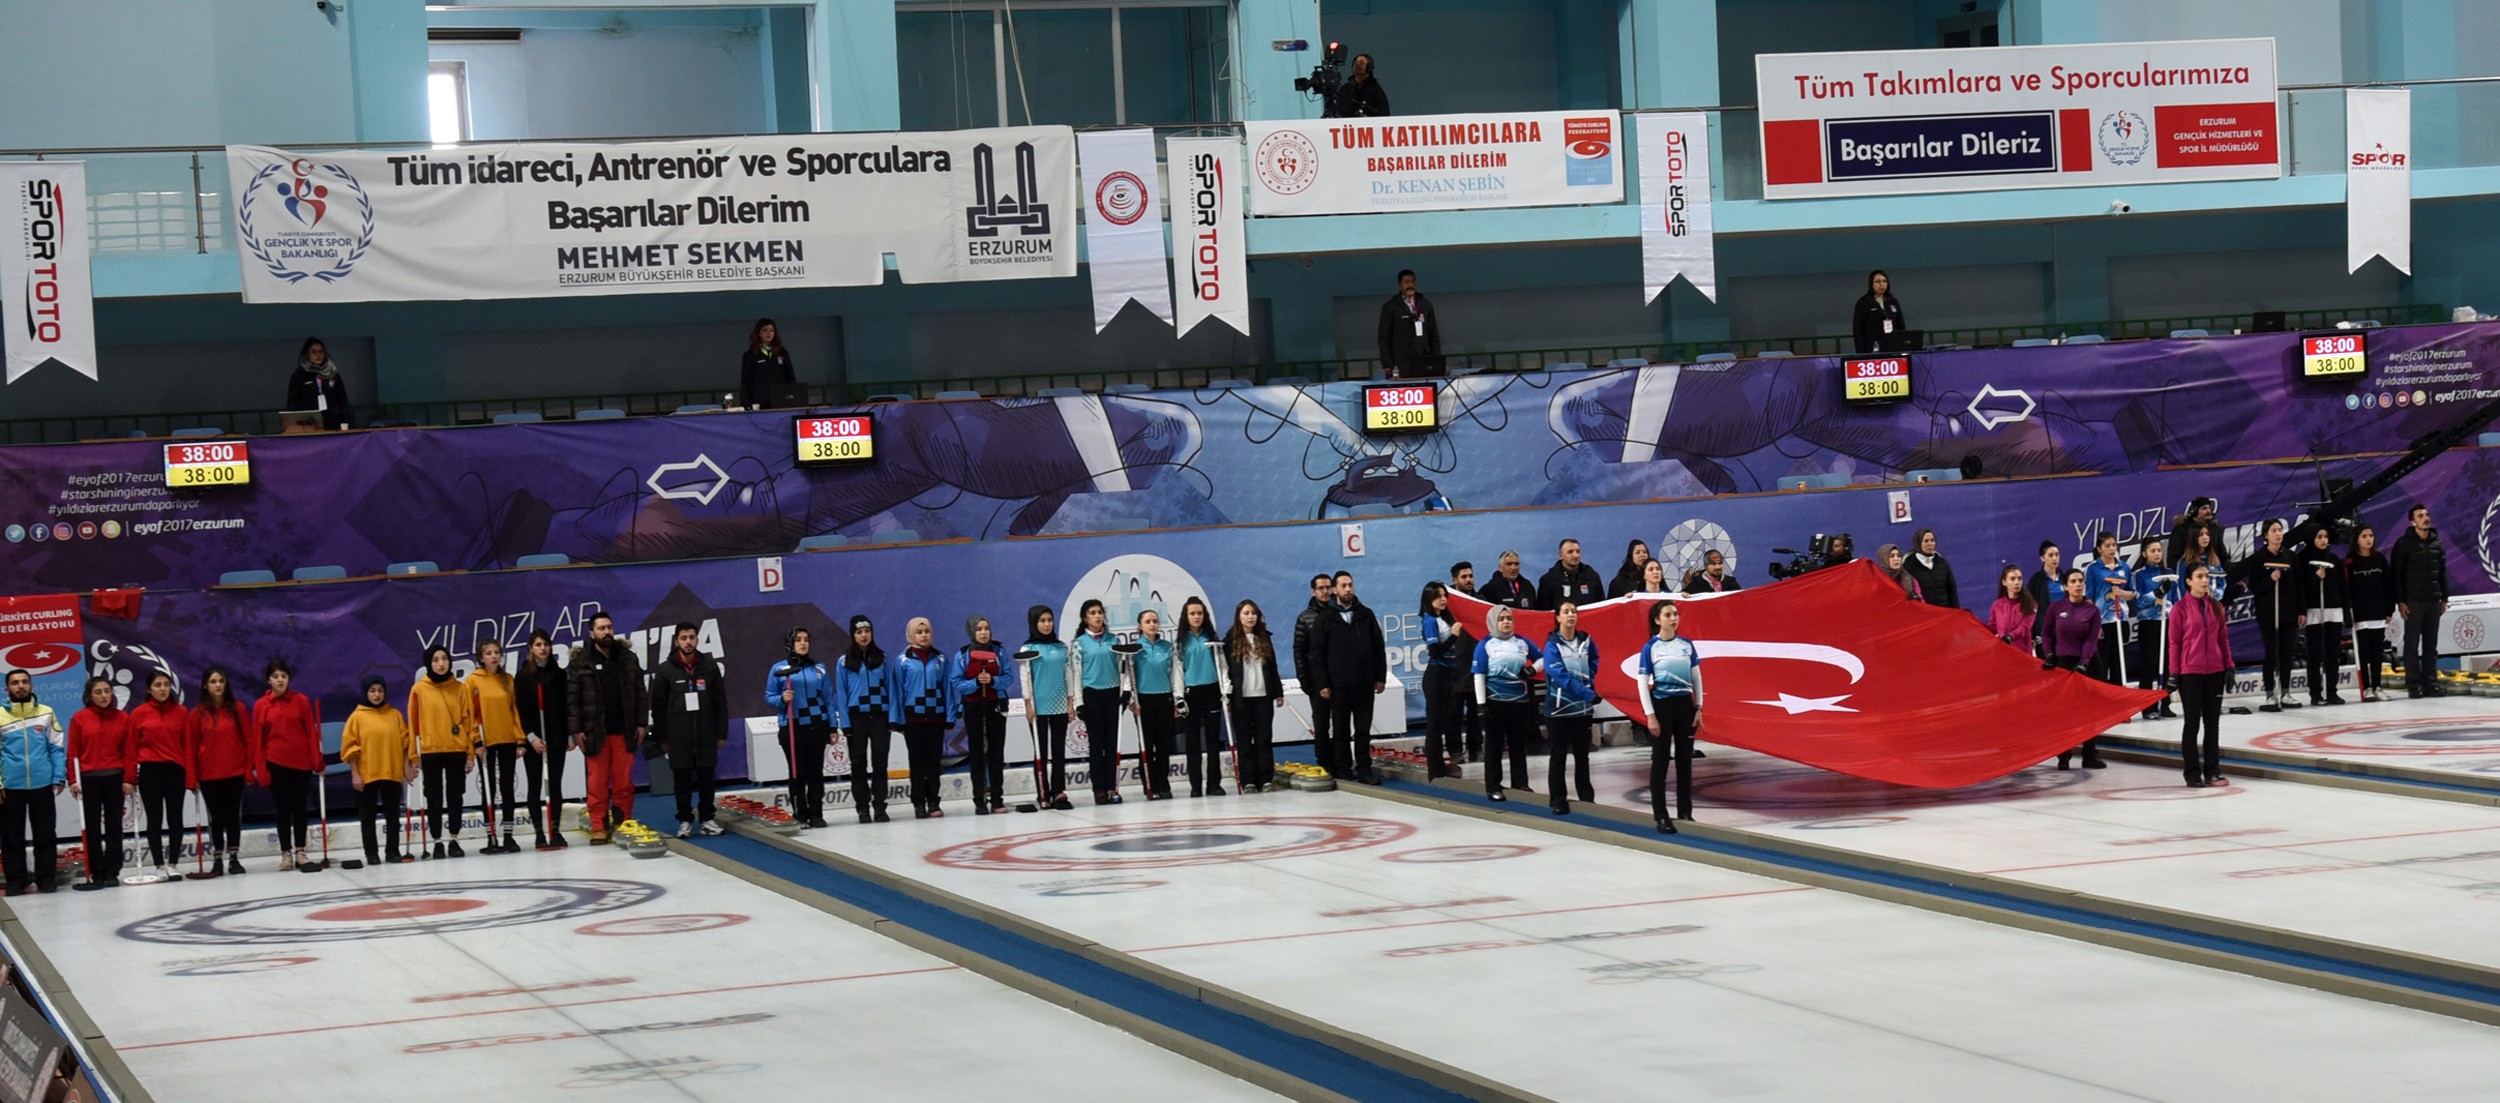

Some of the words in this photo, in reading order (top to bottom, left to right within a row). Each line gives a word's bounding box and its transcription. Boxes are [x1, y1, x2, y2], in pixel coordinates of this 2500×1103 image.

[1795, 75, 1853, 99] Tüm
[1864, 68, 2001, 98] Takımlara
[2011, 72, 2042, 92] ve
[2051, 61, 2251, 89] Sporcularımıza
[2199, 117, 2236, 127] ERZURUM
[1329, 125, 1372, 150] TÜM
[1382, 120, 1543, 147] KATILIMCILARA
[2173, 131, 2207, 142] GENÇLİK
[2253, 129, 2263, 138] VE
[1841, 140, 1953, 167] Başarılar
[1962, 133, 2041, 158] Dileriz
[2178, 145, 2199, 154] SPOR
[387, 155, 462, 186] Tüm
[467, 152, 583, 188] idareci,
[587, 146, 729, 182] Antrenör
[739, 153, 776, 177] ve
[786, 145, 951, 181] Sporculara
[1367, 155, 1446, 174] BAŞARILAR
[1450, 151, 1507, 169] DİLERİM
[2352, 153, 2406, 166] SPOR
[1371, 180, 1394, 195] Dr.
[1398, 178, 1455, 193] KENAN
[1458, 173, 1506, 195] ŞEBİN
[548, 199, 691, 233] Başarılar
[697, 194, 810, 225] Dilerim
[264, 238, 309, 249] GENÇLİK
[311, 238, 324, 247] VE
[326, 238, 353, 247] SPOR
[968, 239, 1052, 256] ERZURUM
[281, 249, 338, 258] BAKANLIĞI
[557, 244, 680, 269] MEHMET
[687, 239, 804, 265] SEKMEN
[559, 272, 616, 284] ERZURUM
[619, 267, 694, 283] BÜYÜKŞEHİR
[697, 265, 753, 279] BELEDİYE
[756, 265, 805, 278] BAŞKANI
[2315, 337, 2355, 354] 38:00
[1857, 360, 1899, 377] 38:00
[2316, 357, 2355, 373] 38:00
[1858, 380, 1899, 397] 38:00
[1379, 390, 1424, 406] 38:00
[1381, 410, 1424, 426] 38:00
[811, 420, 861, 437] 38:00
[182, 445, 234, 463] 38:00
[813, 441, 861, 458] 38:00
[184, 466, 235, 483] 38:00
[1895, 501, 1907, 519] B
[134, 517, 245, 536] eyof2017erzurum
[1348, 534, 1361, 553] C
[763, 568, 780, 588] D
[32, 609, 73, 620] CURLING
[1, 620, 75, 634] EDERASYONU
